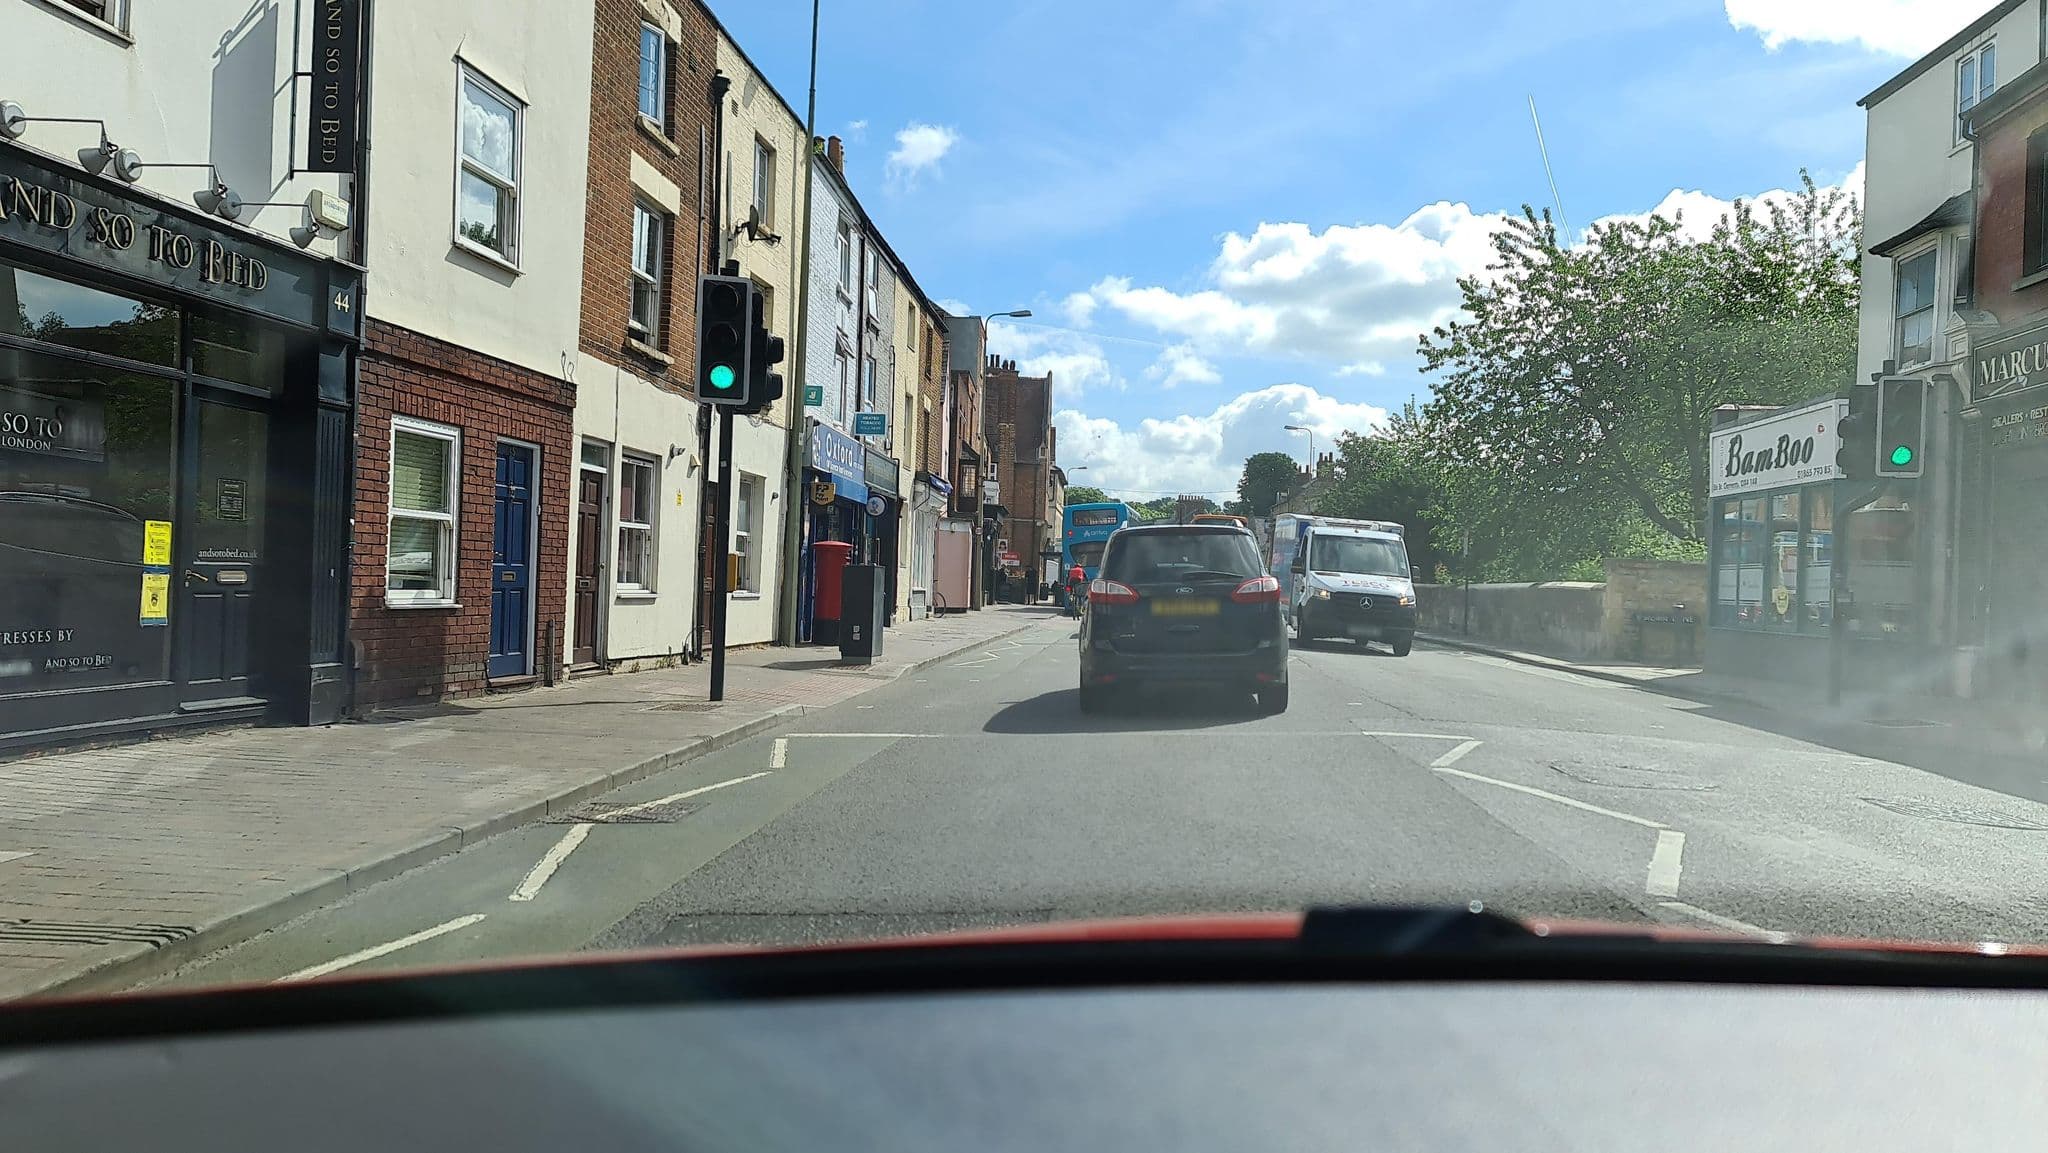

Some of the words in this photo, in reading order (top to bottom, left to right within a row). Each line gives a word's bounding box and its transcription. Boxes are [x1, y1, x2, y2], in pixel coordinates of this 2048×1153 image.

[325, 48, 340, 73] SO
[324, 81, 339, 109] TO
[320, 118, 340, 163] BED
[0, 177, 76, 229] ND
[96, 207, 134, 250] SO
[151, 225, 193, 268] TO
[207, 239, 267, 290] BED
[334, 292, 350, 313] 44
[1980, 341, 2048, 387] MARCU
[2, 412, 29, 434] SO
[35, 416, 62, 439] TO
[1992, 412, 2024, 428] DEALERS
[2, 435, 51, 451] LONDON
[826, 433, 853, 467] Oxford
[198, 548, 258, 558] andsotobed.co.uk
[0, 630, 52, 645] RESSES
[58, 629, 74, 641] BY
[69, 657, 80, 667] SO
[82, 657, 94, 666] TO
